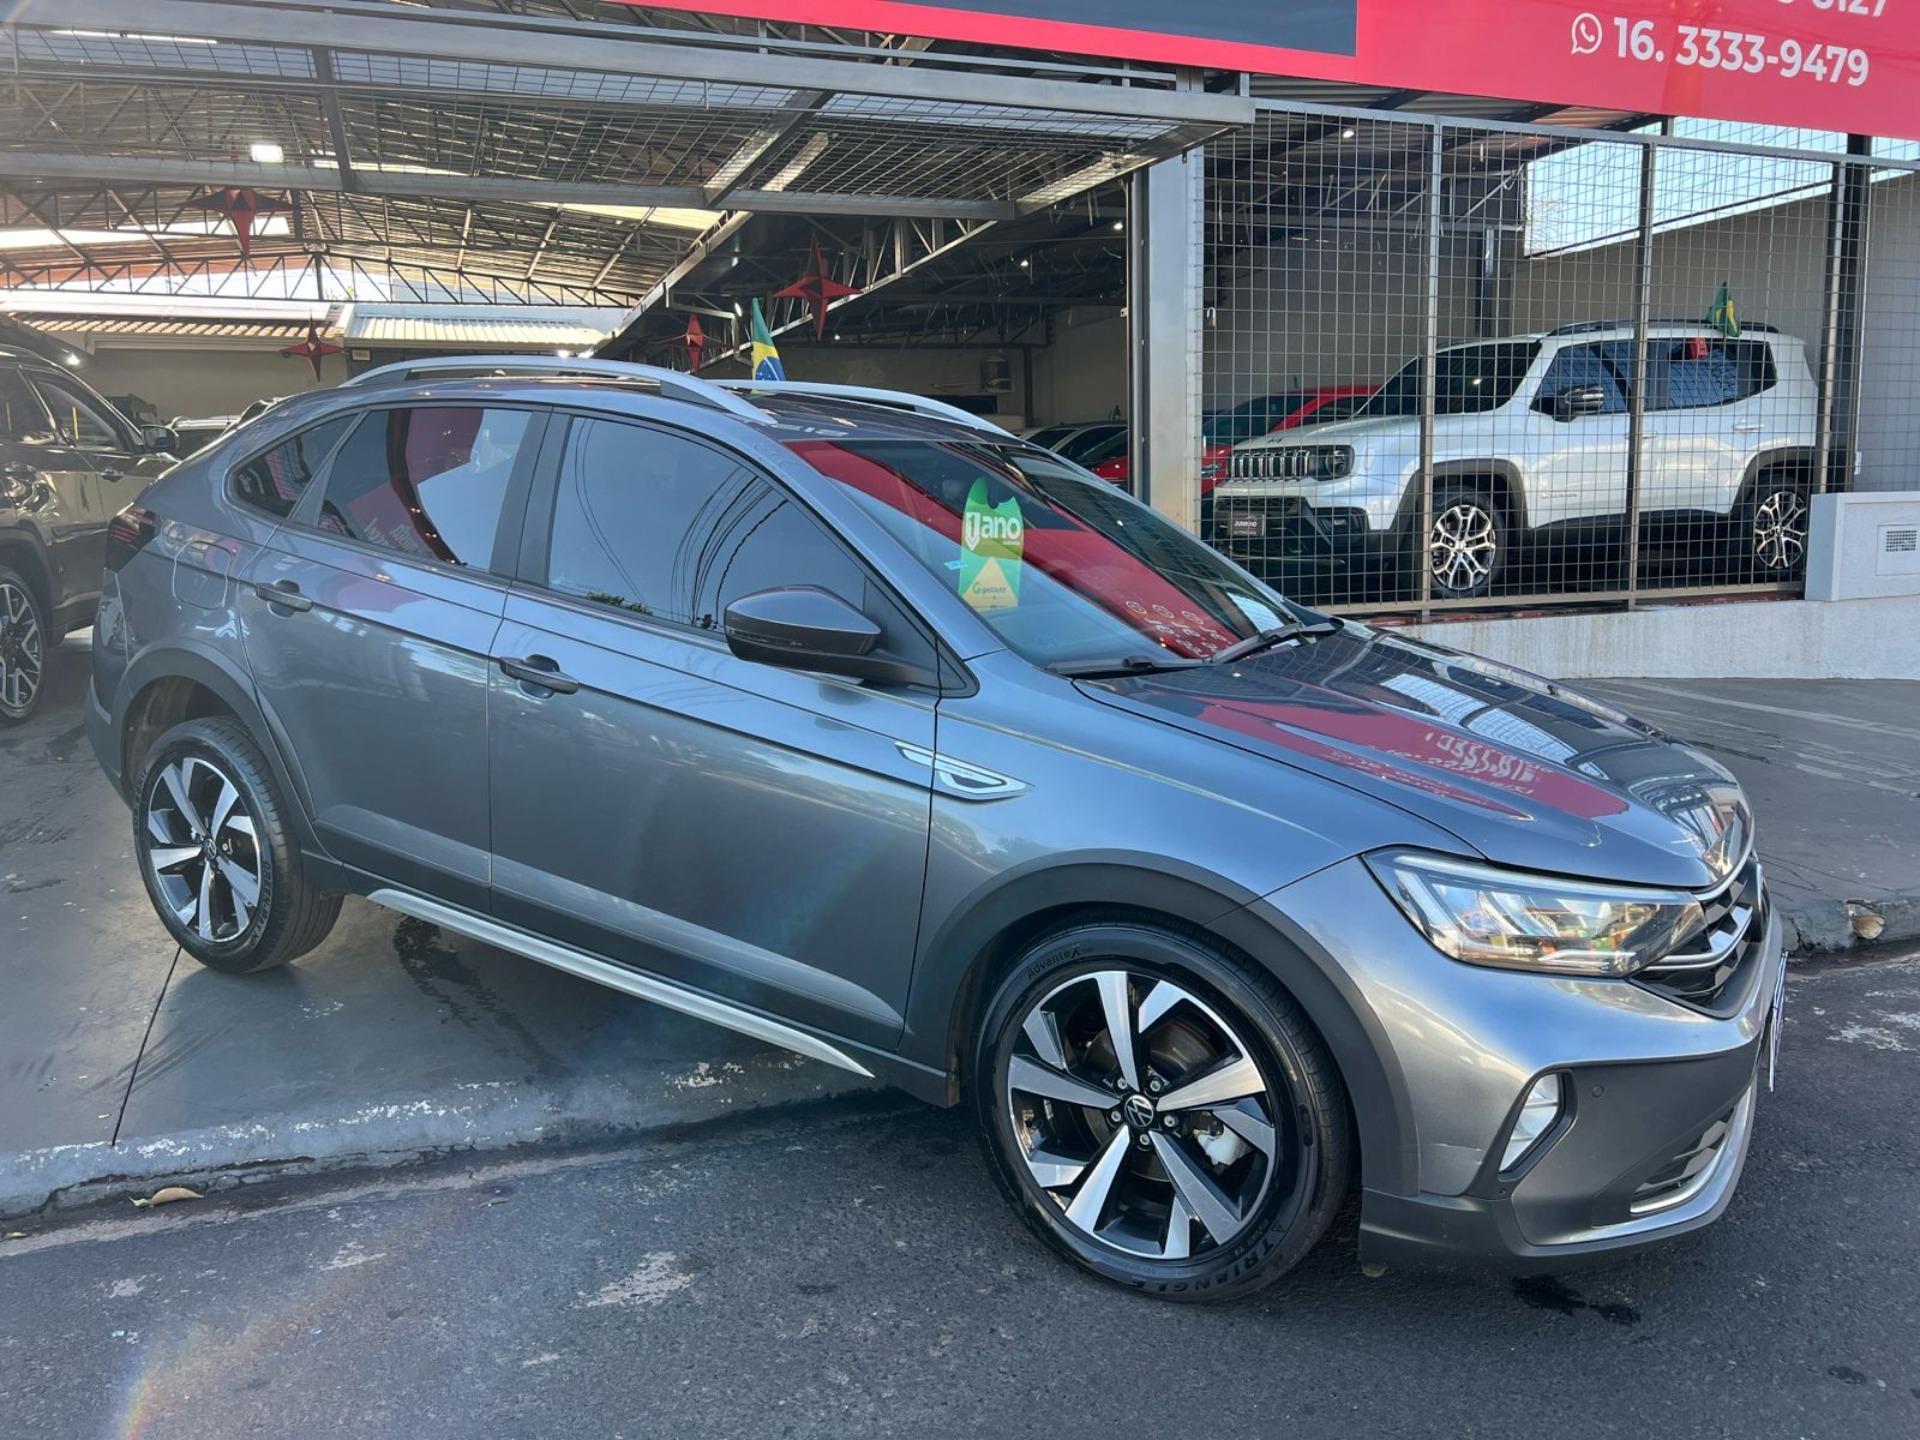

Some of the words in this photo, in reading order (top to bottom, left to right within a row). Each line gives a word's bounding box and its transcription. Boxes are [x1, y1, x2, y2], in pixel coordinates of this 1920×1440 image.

[1614, 16, 1664, 62] 16.
[1675, 25, 1869, 86] 3333-9479
[981, 515, 1021, 540] ano
